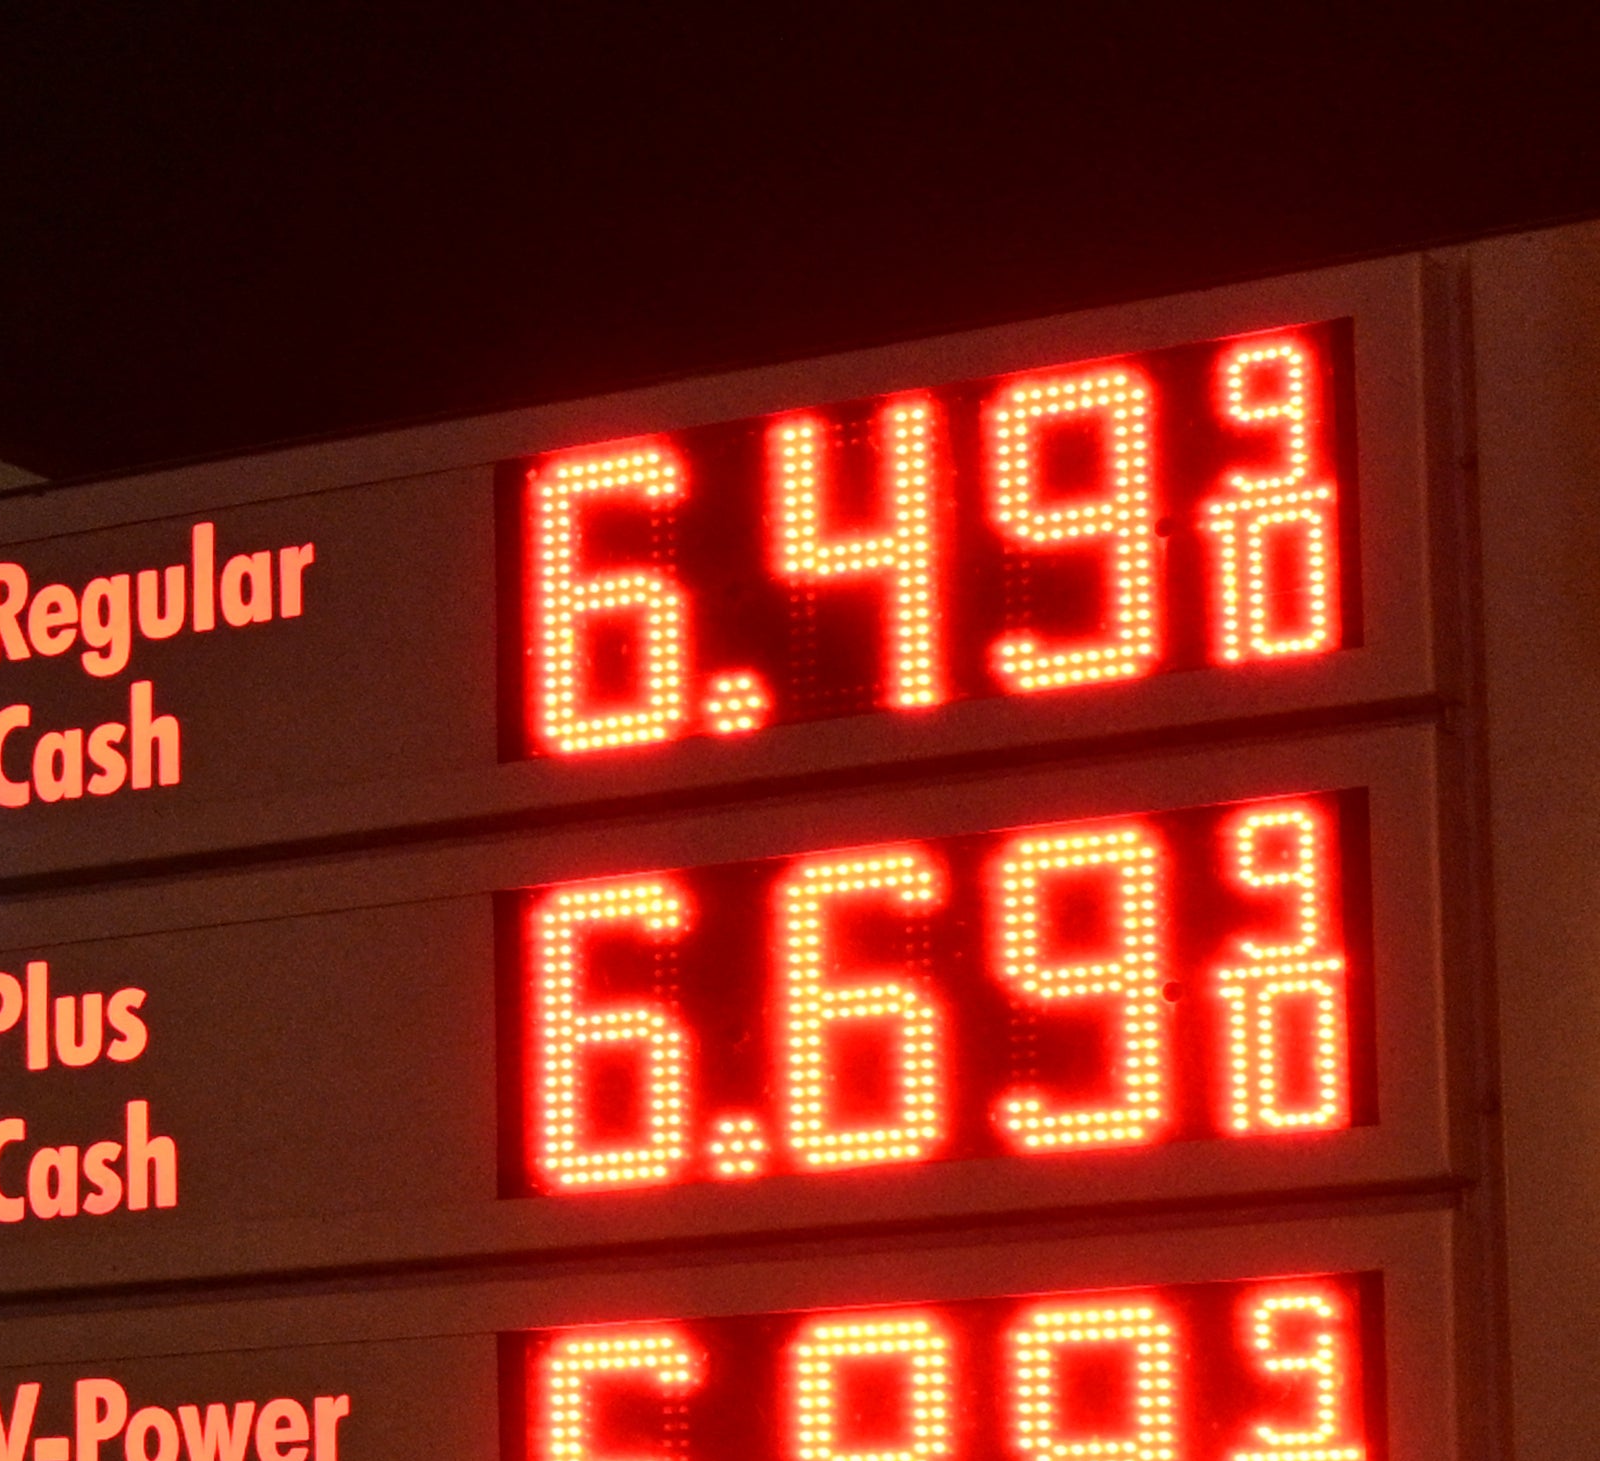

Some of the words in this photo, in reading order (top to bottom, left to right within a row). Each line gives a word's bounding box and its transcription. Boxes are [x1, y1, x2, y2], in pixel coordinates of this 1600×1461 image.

[1228, 345, 1305, 493] 9
[539, 371, 1154, 753] 6.49
[1208, 507, 1328, 661] 10
[1237, 809, 1319, 957] 9
[538, 828, 1166, 1187] 6.69
[1222, 984, 1346, 1132] 10
[1252, 1293, 1338, 1443] 9
